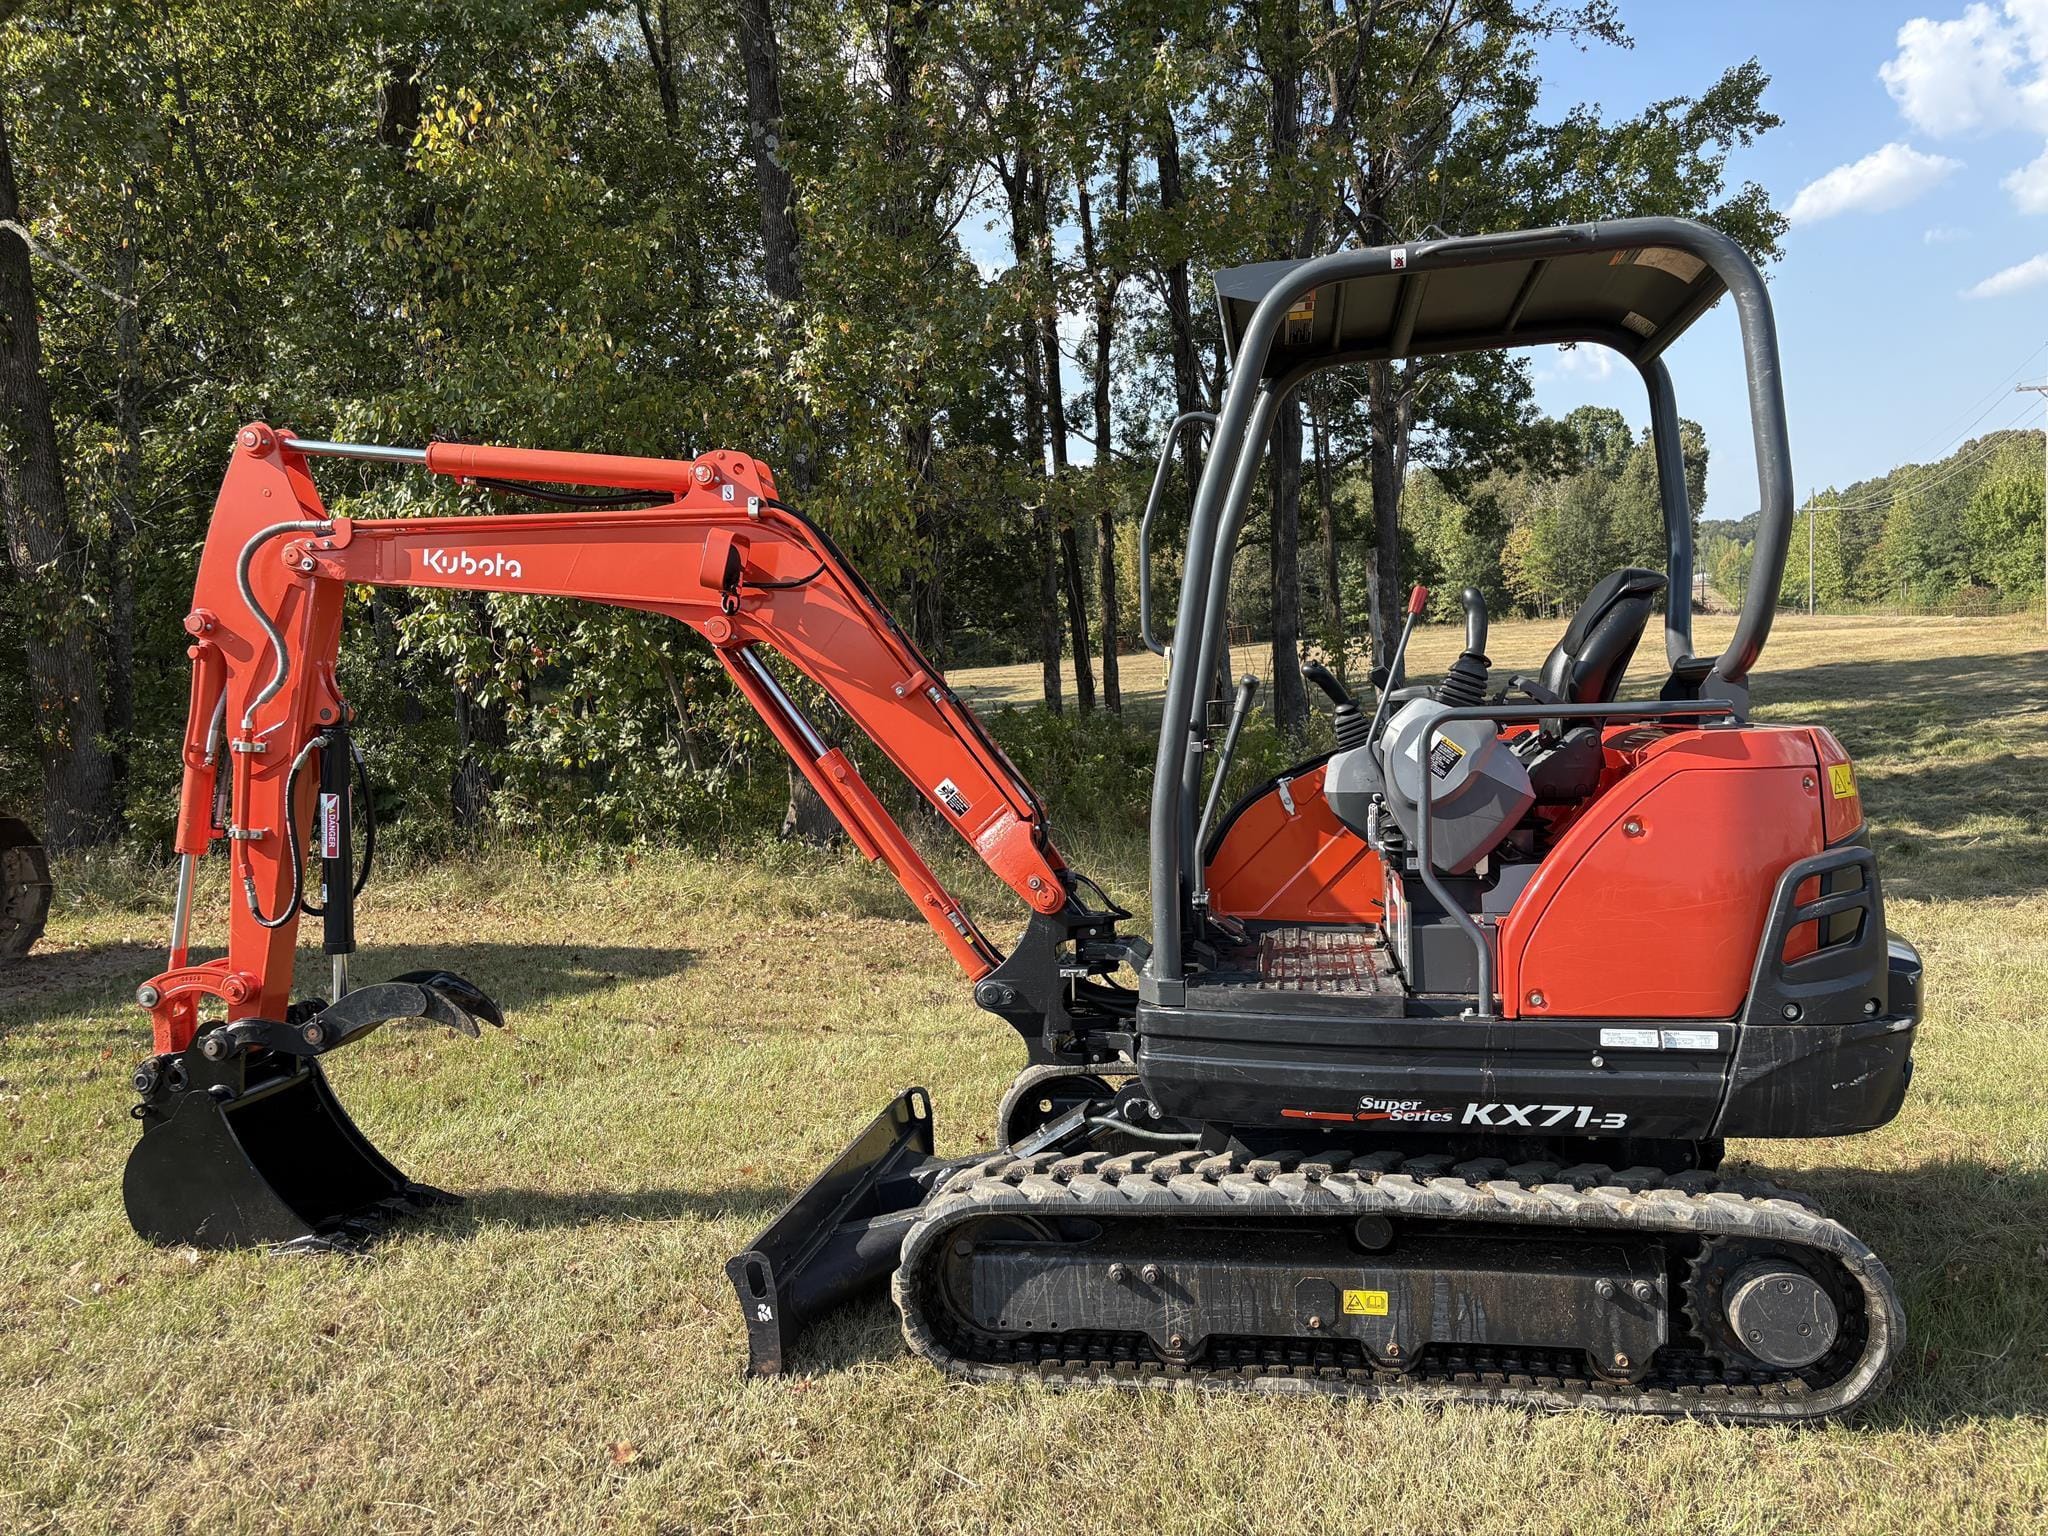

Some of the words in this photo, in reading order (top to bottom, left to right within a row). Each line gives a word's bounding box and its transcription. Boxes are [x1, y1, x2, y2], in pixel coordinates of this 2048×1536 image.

[423, 548, 522, 578] Kubota
[328, 814, 337, 849] DANGER
[1360, 1097, 1422, 1113] Super
[1389, 1109, 1453, 1122] Series
[1460, 1102, 1628, 1129] KX71-3
